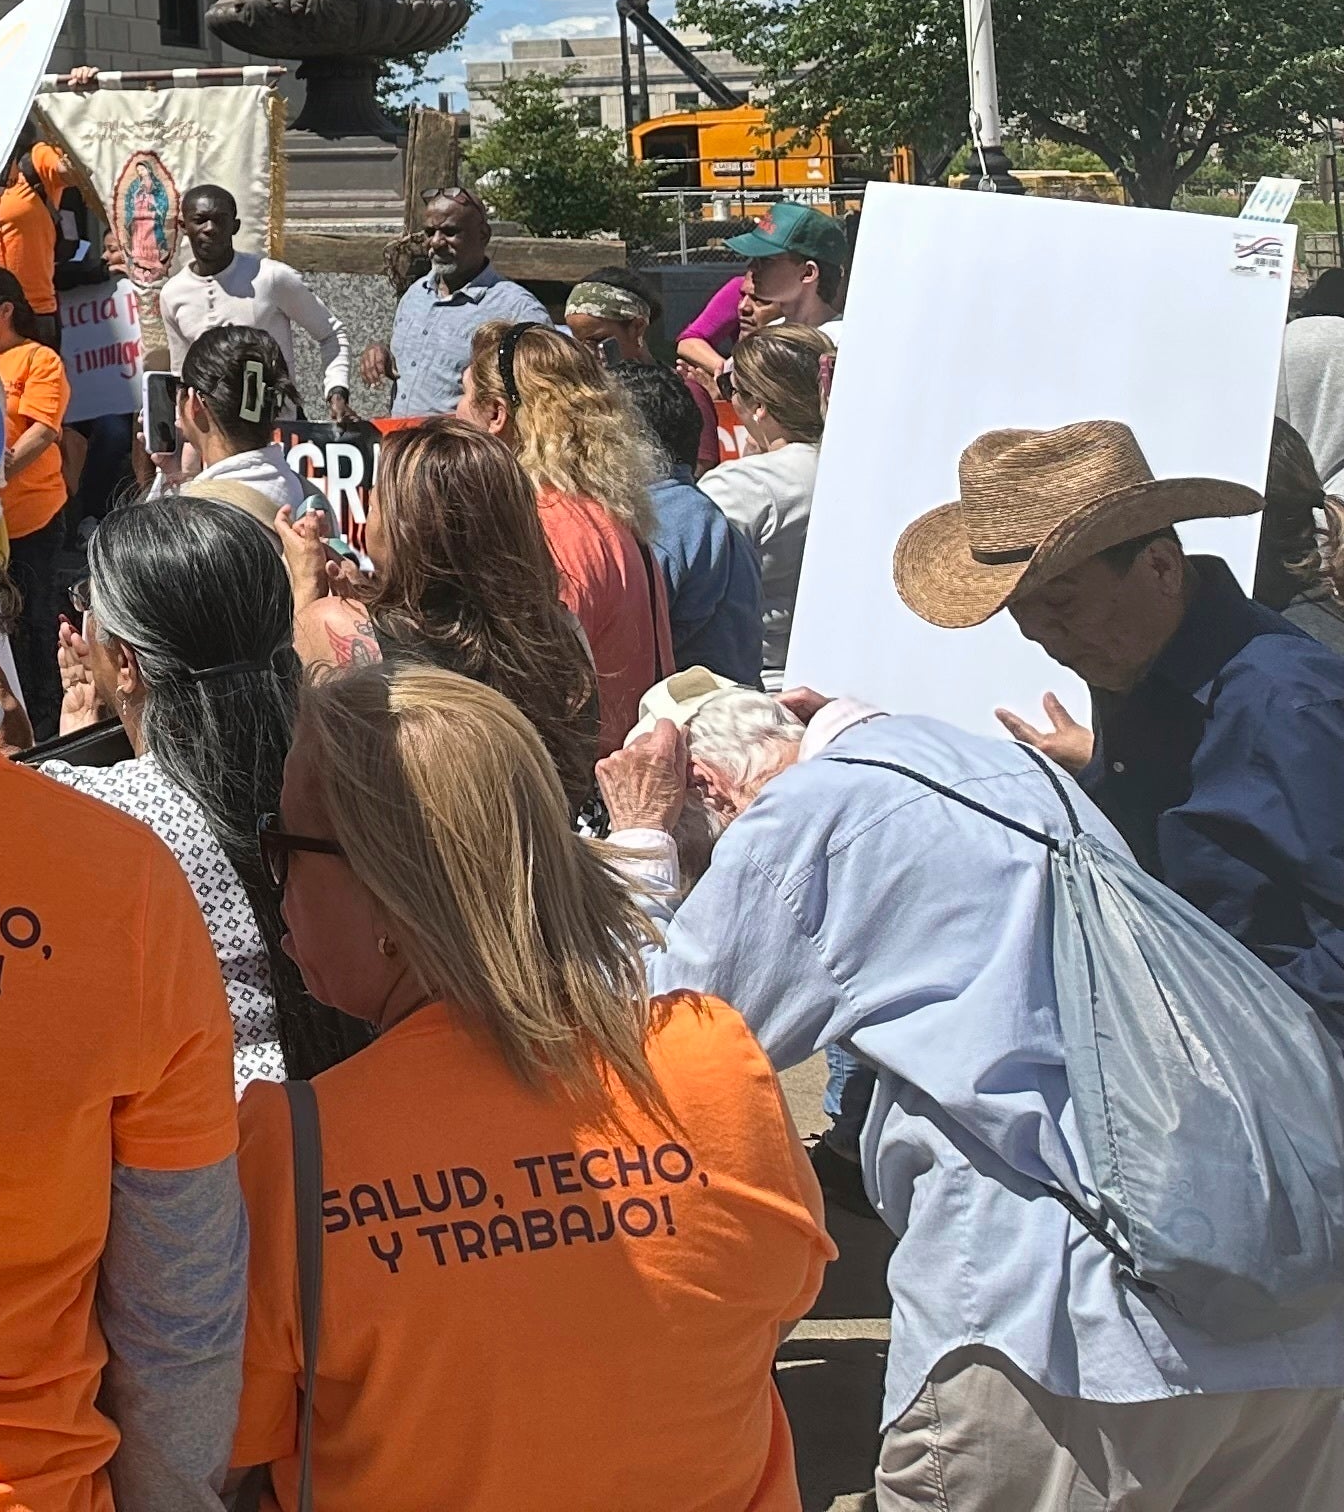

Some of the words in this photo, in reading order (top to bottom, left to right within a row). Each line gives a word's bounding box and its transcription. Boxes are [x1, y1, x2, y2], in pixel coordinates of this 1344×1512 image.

[513, 1143, 709, 1198] TECHO,
[368, 1231, 403, 1273] Y
[417, 1195, 676, 1266] TRABAJO!
